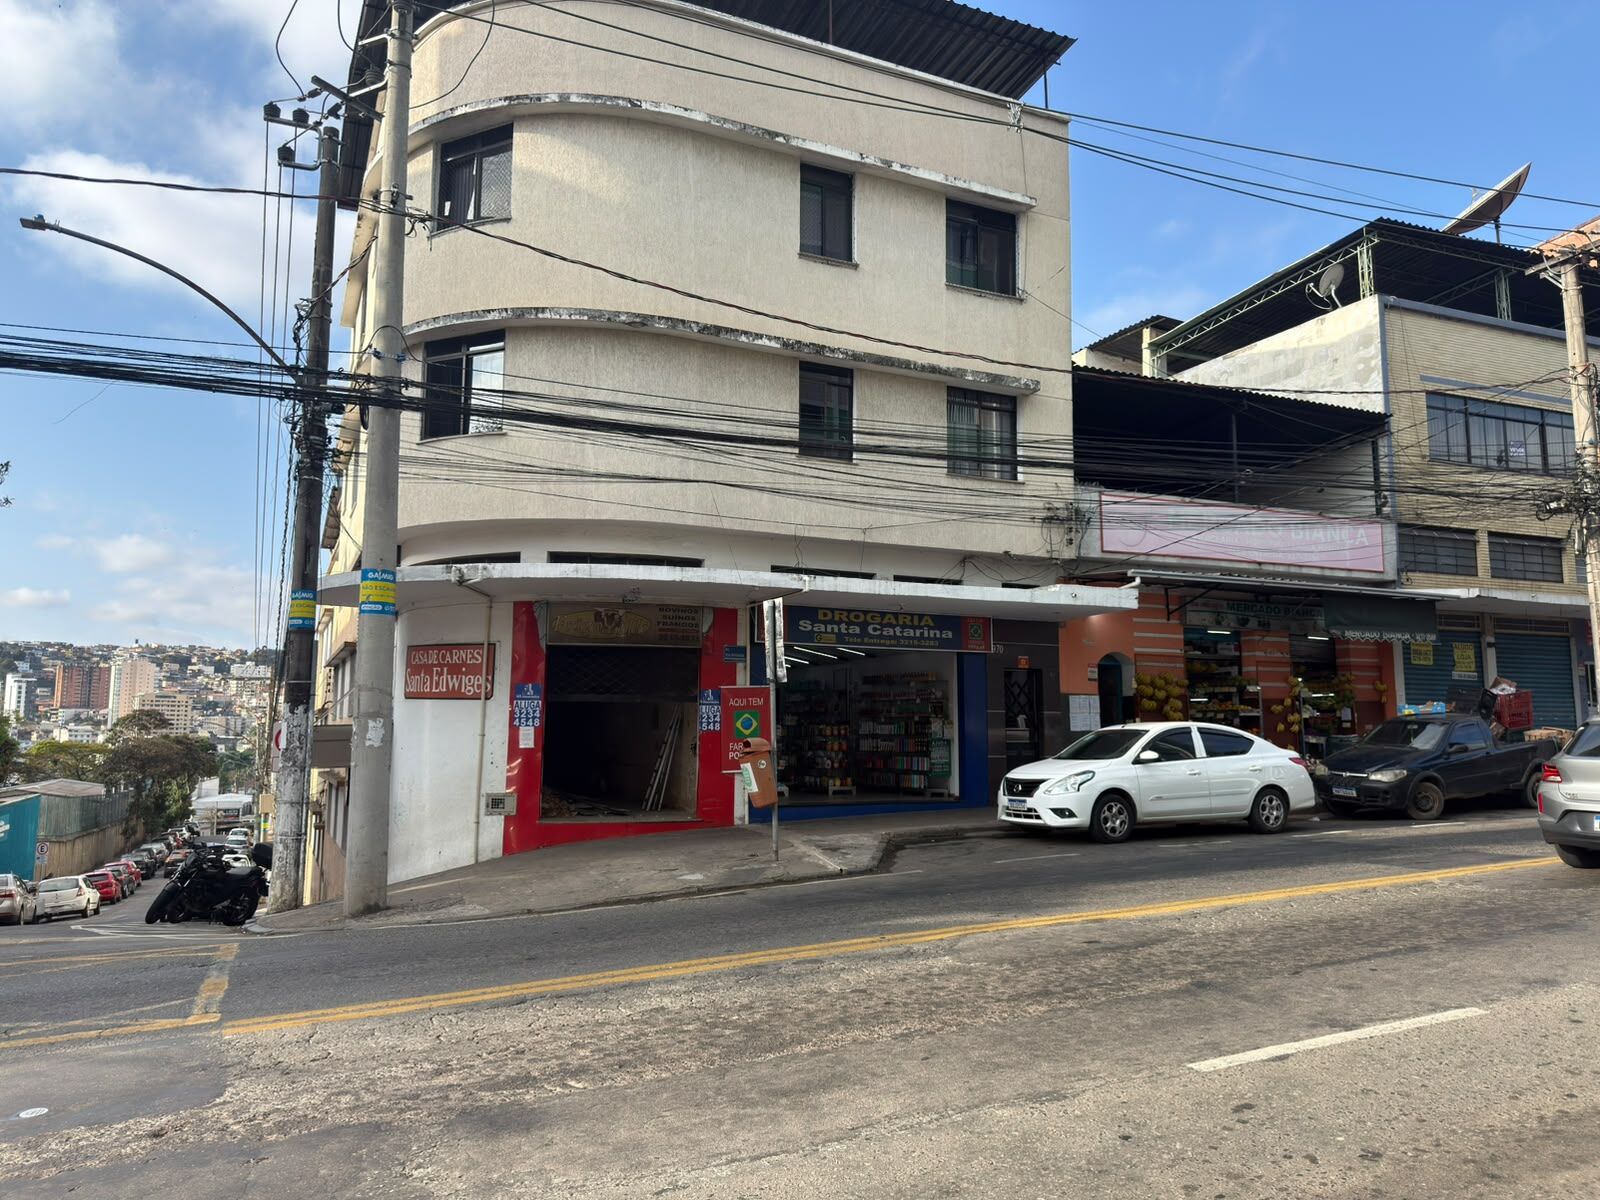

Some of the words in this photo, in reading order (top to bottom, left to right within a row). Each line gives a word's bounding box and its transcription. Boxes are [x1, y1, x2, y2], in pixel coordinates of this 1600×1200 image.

[1227, 601, 1281, 615] MERCADO
[817, 609, 936, 627] DROGARIA
[799, 619, 861, 635] Santa
[867, 623, 953, 639] Catarina
[1344, 629, 1381, 638] MERCADO
[411, 650, 428, 664] CASA
[428, 650, 438, 664] DE
[439, 648, 483, 664] CARNES
[405, 668, 430, 692] Santa
[431, 666, 492, 696] Edwiges
[729, 698, 747, 707] AQUI
[748, 697, 764, 706] TEM
[514, 708, 540, 718] 3234
[699, 705, 721, 714] LUGA
[513, 718, 540, 727] 4548
[699, 722, 720, 731] 548
[729, 742, 744, 751] FAR
[728, 751, 744, 760] PO
[40, 845, 45, 853] E
